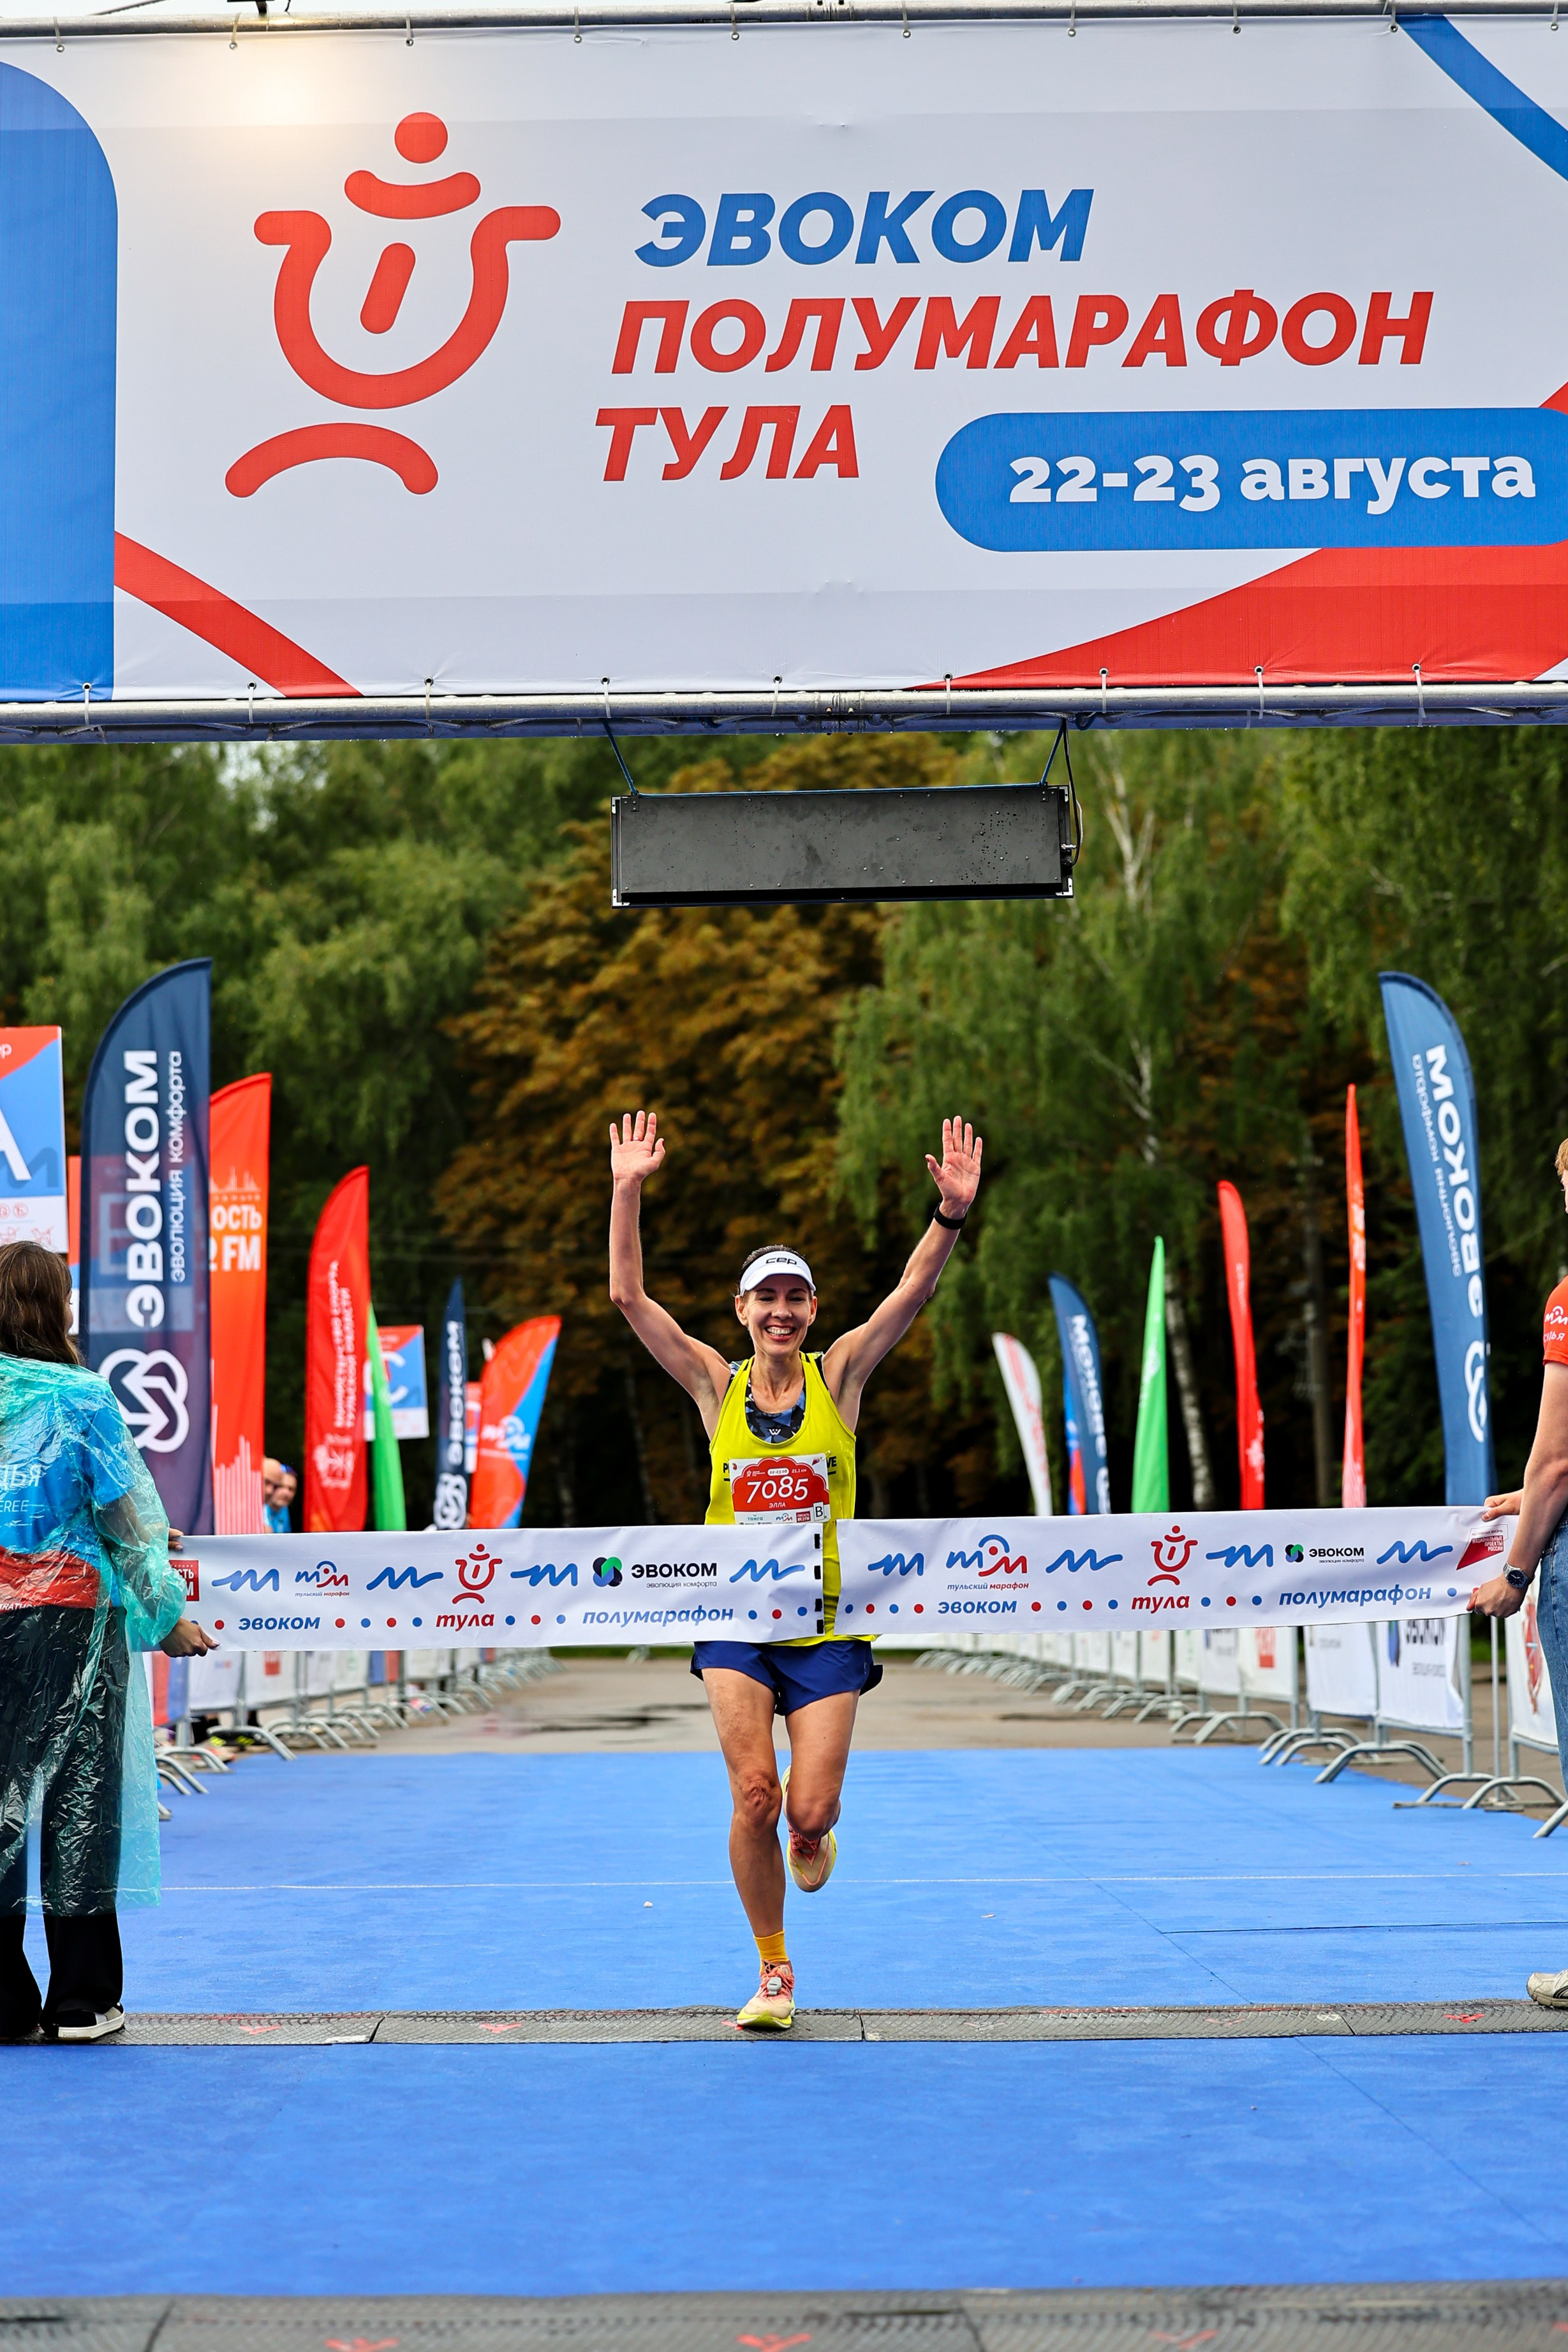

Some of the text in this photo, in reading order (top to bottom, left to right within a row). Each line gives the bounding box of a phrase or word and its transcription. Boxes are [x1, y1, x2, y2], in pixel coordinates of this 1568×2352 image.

[635, 189, 1094, 267] ЭВОКОМ
[611, 289, 1435, 375] ПОЛУМАРАФОН
[594, 404, 860, 482] ТУЛА
[1008, 454, 1536, 514] 22-23 августа
[165, 1051, 187, 1282] эволюция комфорта
[124, 1050, 165, 1328] ЭВОКОМ
[211, 1205, 262, 1231] ОСТЬ
[222, 1235, 262, 1271] FM
[747, 1476, 808, 1504] 7085
[1309, 1548, 1364, 1557] ЭВОКОМ
[631, 1563, 716, 1578] ЭВОКОМ
[947, 1581, 1029, 1591] тульский марафон
[1279, 1584, 1431, 1608] полумарафон
[582, 1605, 734, 1627] полумарафон
[1131, 1595, 1190, 1615] тула
[436, 1612, 494, 1631] тула
